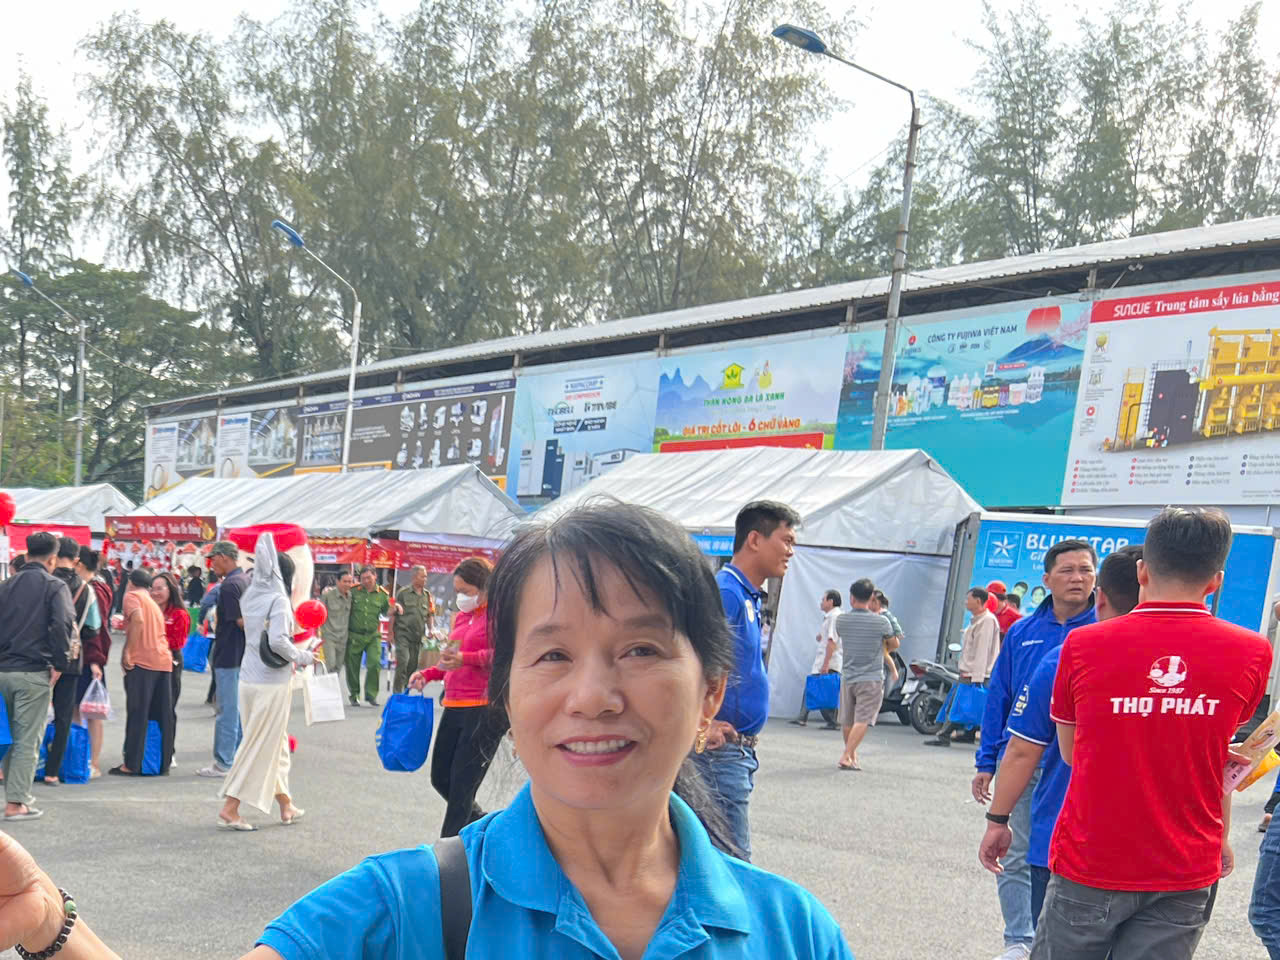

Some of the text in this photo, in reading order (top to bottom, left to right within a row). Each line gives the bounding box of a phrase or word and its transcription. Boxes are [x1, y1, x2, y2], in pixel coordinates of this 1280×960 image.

[1155, 300, 1186, 313] Trung
[1189, 297, 1209, 309] tâm
[1212, 291, 1230, 309] sấy
[1232, 292, 1248, 305] lúa
[1252, 287, 1280, 303] bằng
[927, 324, 1018, 344] CÔNG TY FUJIWA VIỆT NAM
[765, 391, 785, 401] XANH
[748, 418, 756, 432] 6
[777, 415, 801, 430] VÀNG
[1110, 694, 1220, 717] THỌ PHÁT
